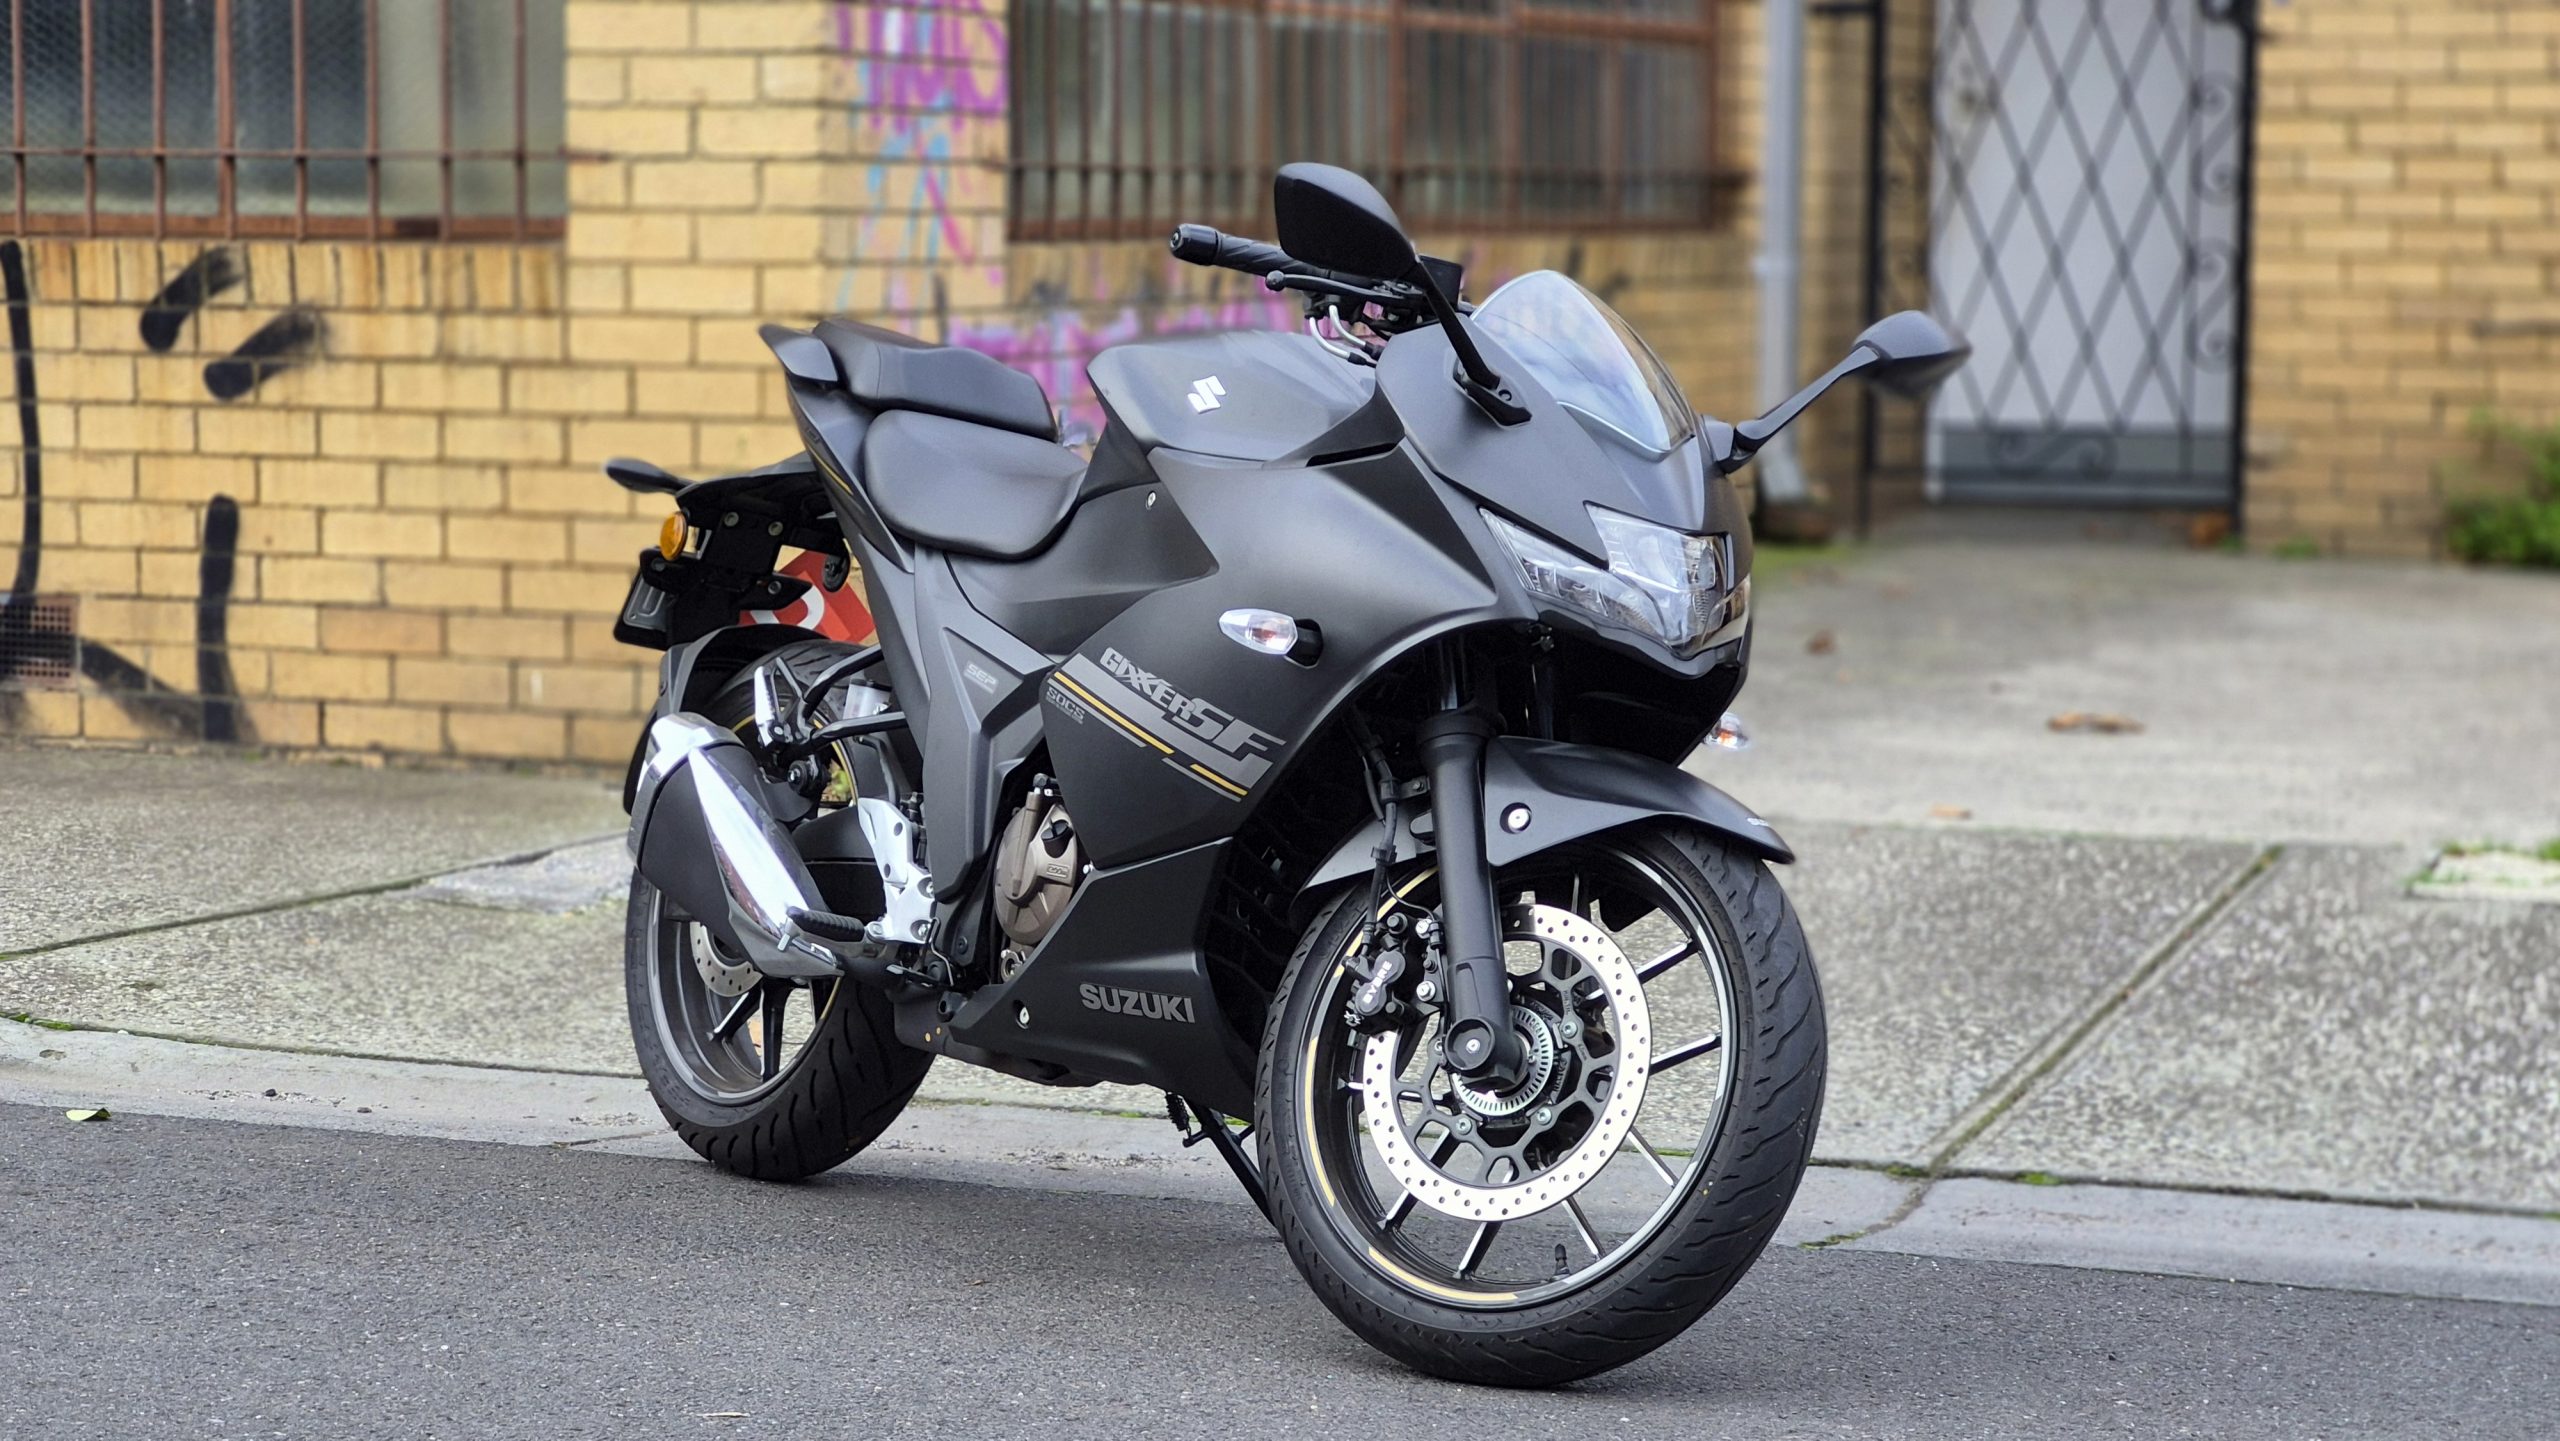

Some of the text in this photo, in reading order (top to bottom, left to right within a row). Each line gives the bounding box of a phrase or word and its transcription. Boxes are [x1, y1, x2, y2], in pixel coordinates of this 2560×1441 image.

[966, 663, 996, 686] SEP
[1047, 687, 1085, 720] SOCS
[1100, 647, 1197, 721] GIXXER
[1172, 697, 1287, 753] SF
[1079, 983, 1195, 1023] SUZUKI
